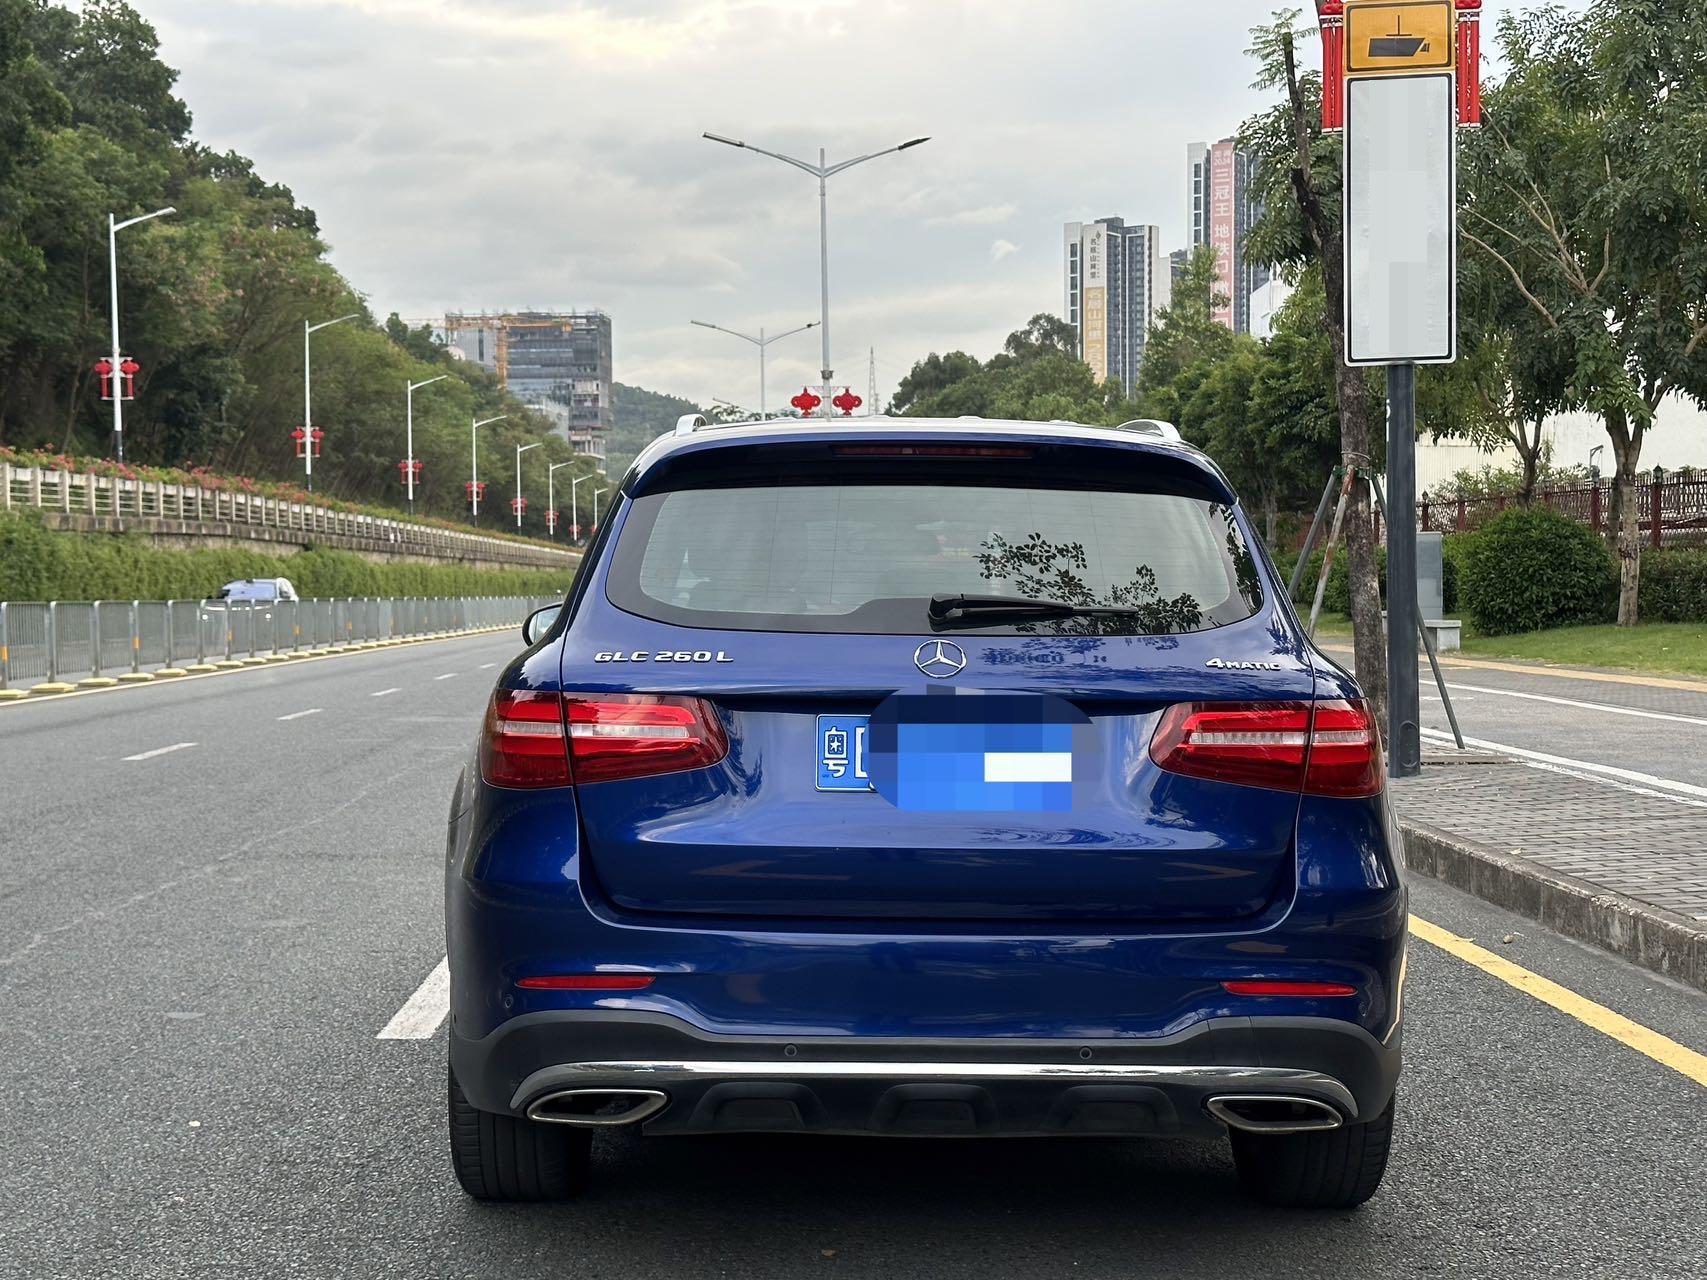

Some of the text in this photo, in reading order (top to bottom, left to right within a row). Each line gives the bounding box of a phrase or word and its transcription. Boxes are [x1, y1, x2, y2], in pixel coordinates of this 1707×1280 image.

[1214, 168, 1230, 217] 三冠王
[594, 651, 734, 663] GLC 260 L
[1205, 656, 1282, 671] 4MATIC
